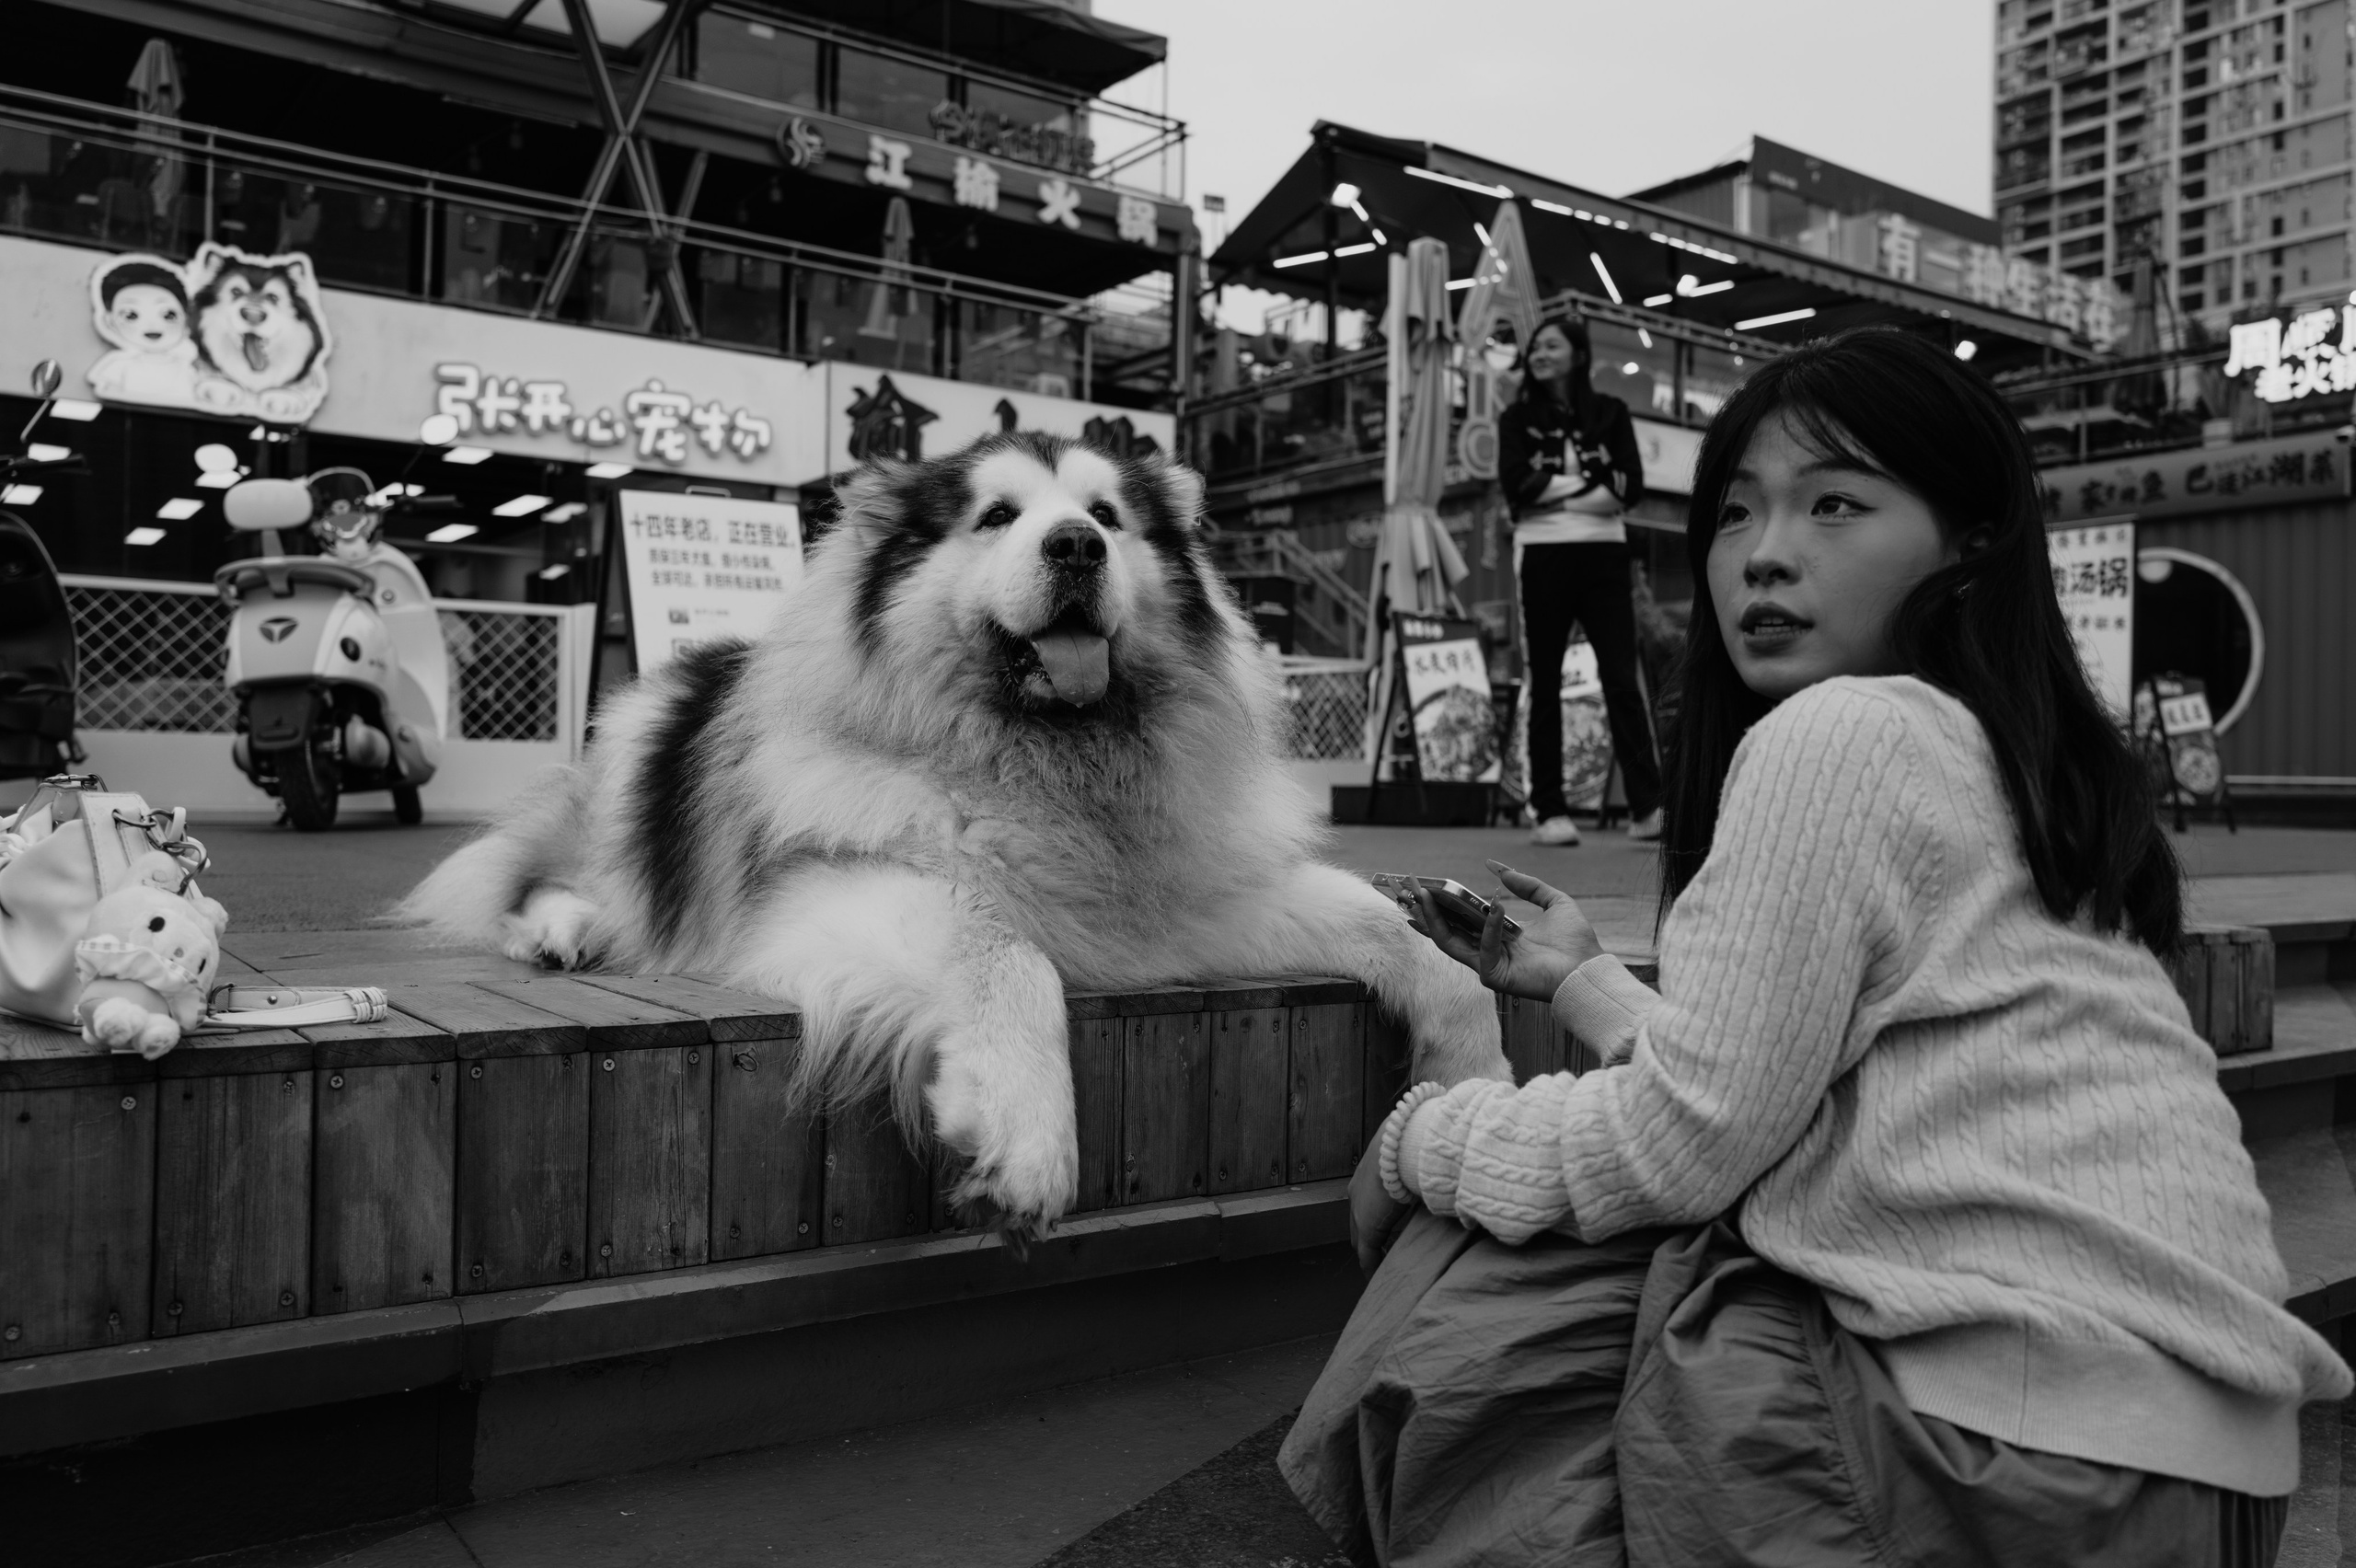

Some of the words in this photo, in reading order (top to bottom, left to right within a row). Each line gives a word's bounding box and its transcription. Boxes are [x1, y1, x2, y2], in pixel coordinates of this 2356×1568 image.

[435, 363, 771, 465] 张开心宠物
